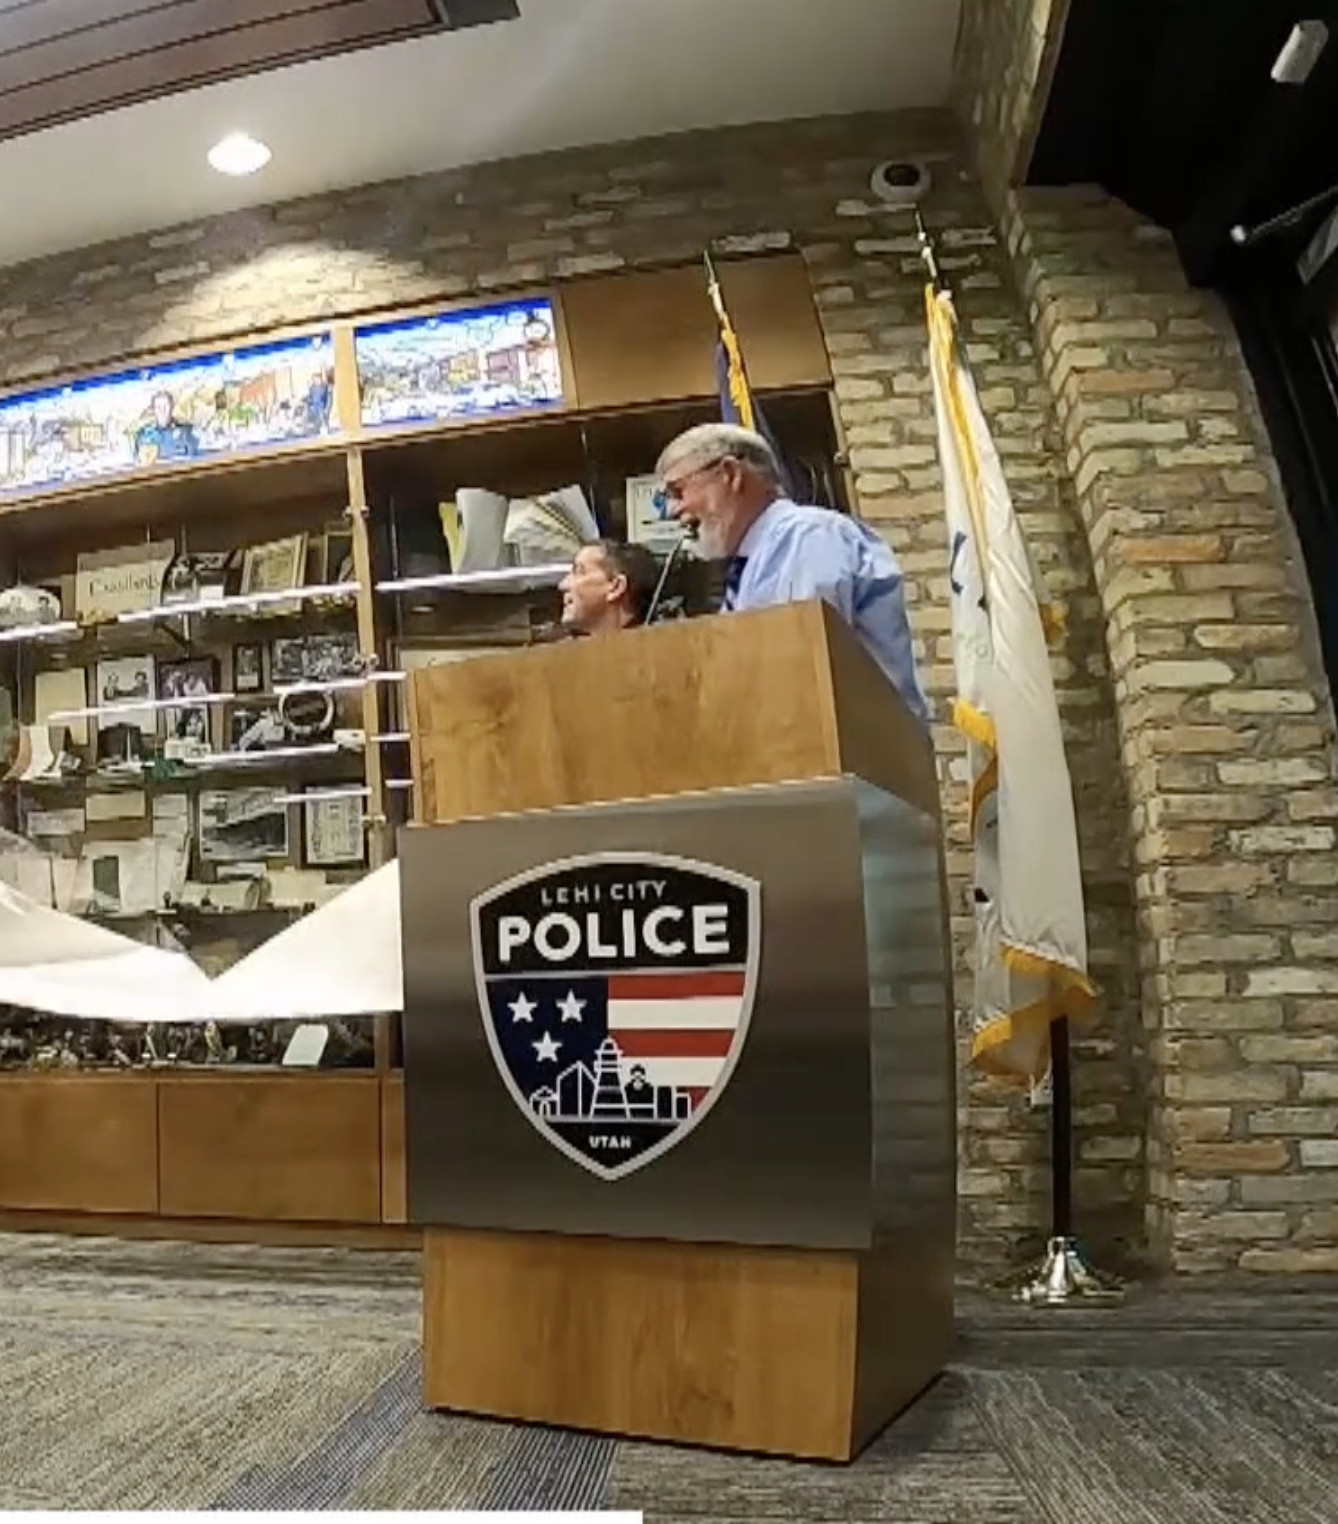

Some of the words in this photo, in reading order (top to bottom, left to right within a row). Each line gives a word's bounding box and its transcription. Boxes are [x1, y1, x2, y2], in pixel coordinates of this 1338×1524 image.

[541, 885, 600, 906] LEHI
[610, 880, 666, 901] CITY
[498, 904, 730, 963] POLICE
[589, 1135, 631, 1149] UTAH
